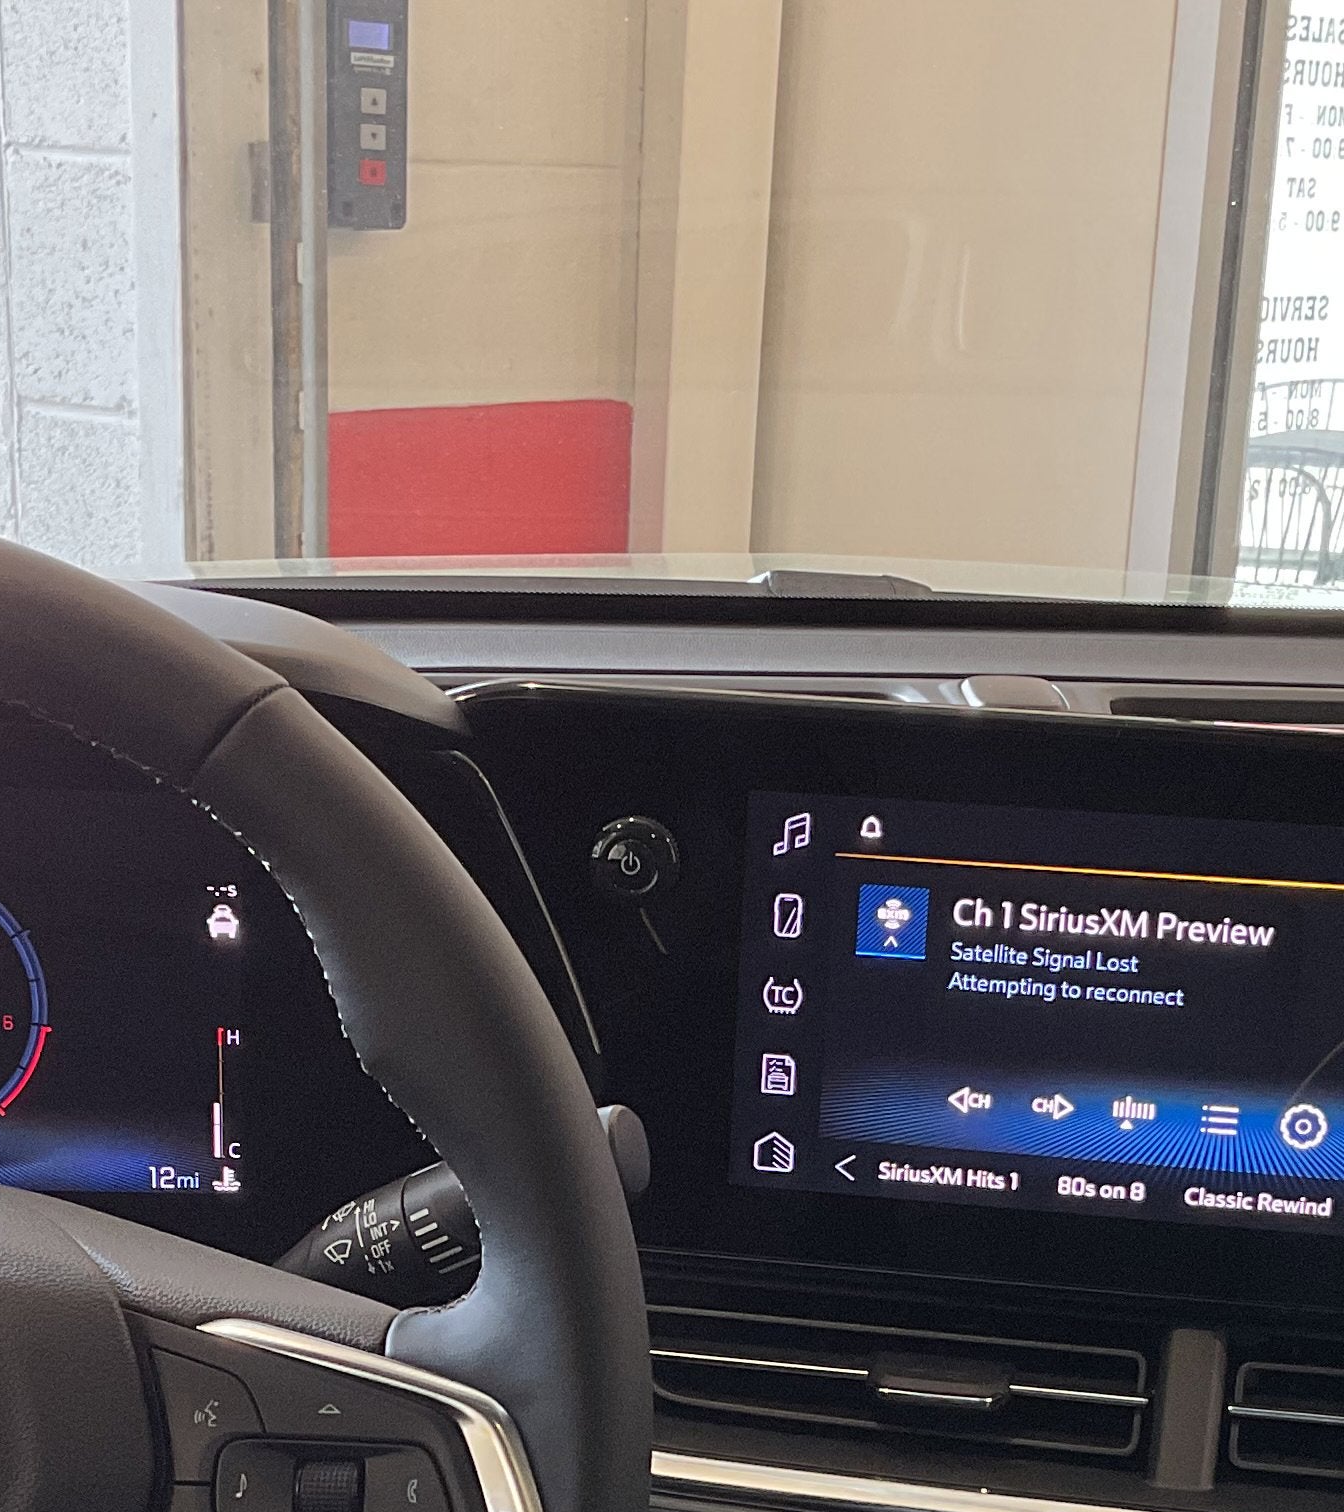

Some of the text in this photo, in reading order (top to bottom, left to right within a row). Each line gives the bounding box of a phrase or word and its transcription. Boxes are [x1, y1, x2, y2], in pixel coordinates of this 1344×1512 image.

[954, 898, 1274, 946] Ch 1 SiriusXM Preview
[951, 942, 1138, 972] Satellite Signal Lost
[947, 972, 1184, 1006] Attempting to reconnect
[3, 1015, 13, 1030] 6
[226, 1029, 241, 1046] H
[228, 1142, 241, 1159] C
[878, 1162, 1018, 1190] SiriusXM Hits 1
[1058, 1176, 1145, 1201] 80s on 8
[363, 1198, 376, 1213] HI
[1184, 1187, 1332, 1216] Classic Rewind
[363, 1212, 377, 1228] LO
[370, 1223, 389, 1241] INT
[370, 1239, 392, 1259] OFF
